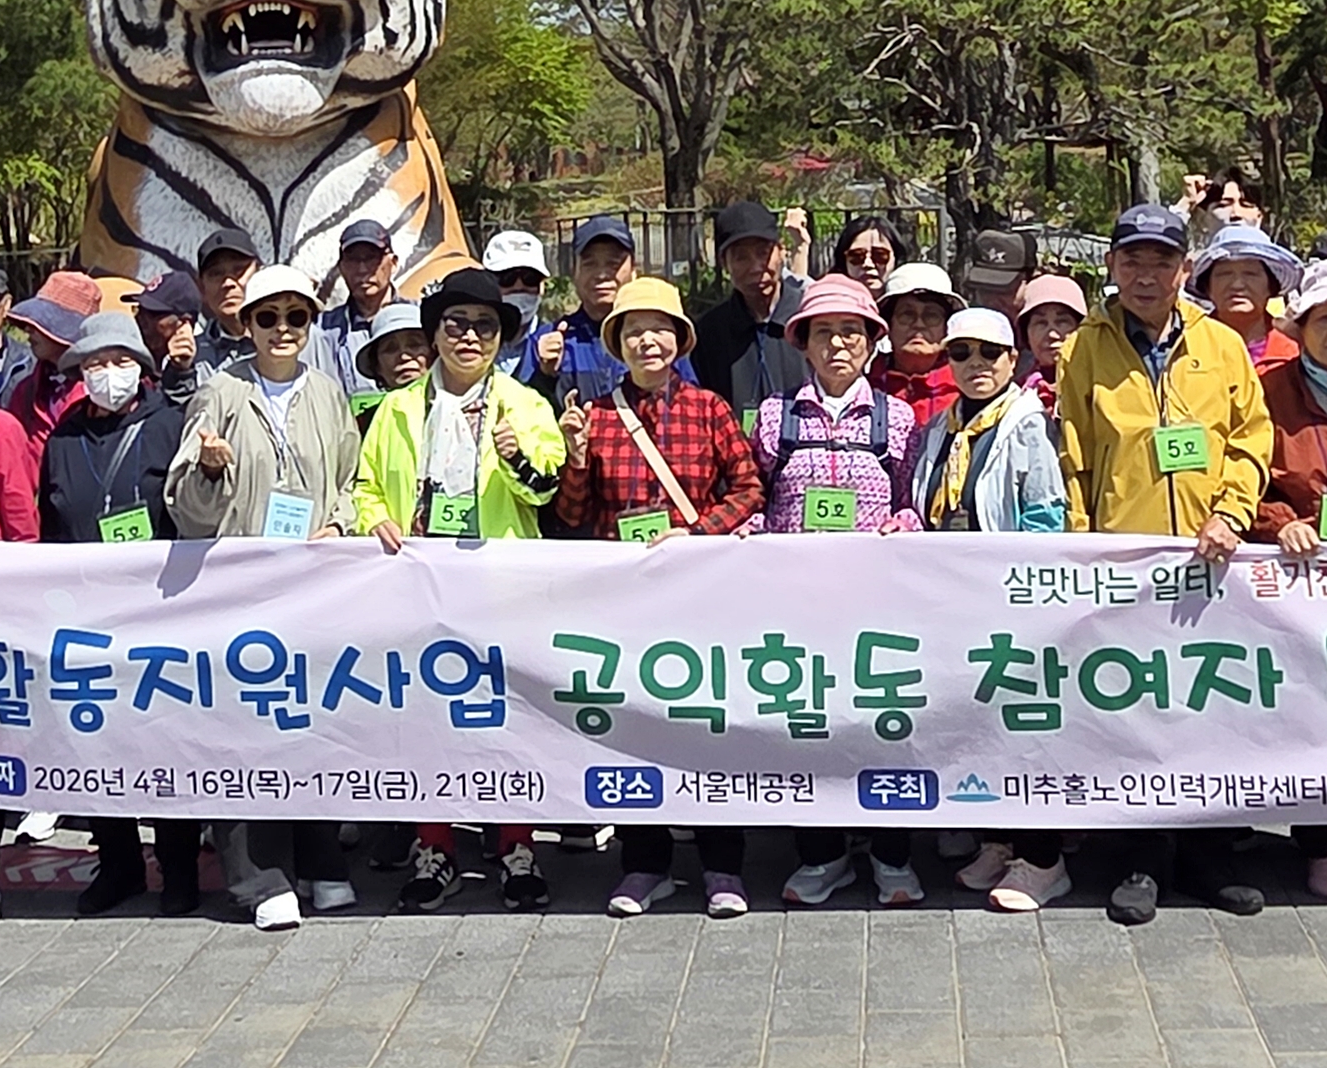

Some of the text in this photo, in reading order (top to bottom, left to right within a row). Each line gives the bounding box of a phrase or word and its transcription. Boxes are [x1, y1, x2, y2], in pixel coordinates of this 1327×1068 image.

[1167, 439, 1199, 458] 5호
[816, 499, 848, 518] 5호
[113, 525, 144, 543] 5호
[1003, 566, 1137, 605] 살맛나는
[1150, 561, 1225, 602] 일터,
[552, 630, 928, 742] 공익활동
[967, 632, 1284, 732] 참여자
[33, 766, 126, 797] 2026년
[133, 767, 177, 798] 4월
[186, 768, 428, 802] 16일(목)~17일(금),
[435, 769, 545, 803] 21일(화)
[596, 771, 655, 804] 장소
[674, 771, 815, 804] 서울대공원
[870, 773, 927, 806] 주최
